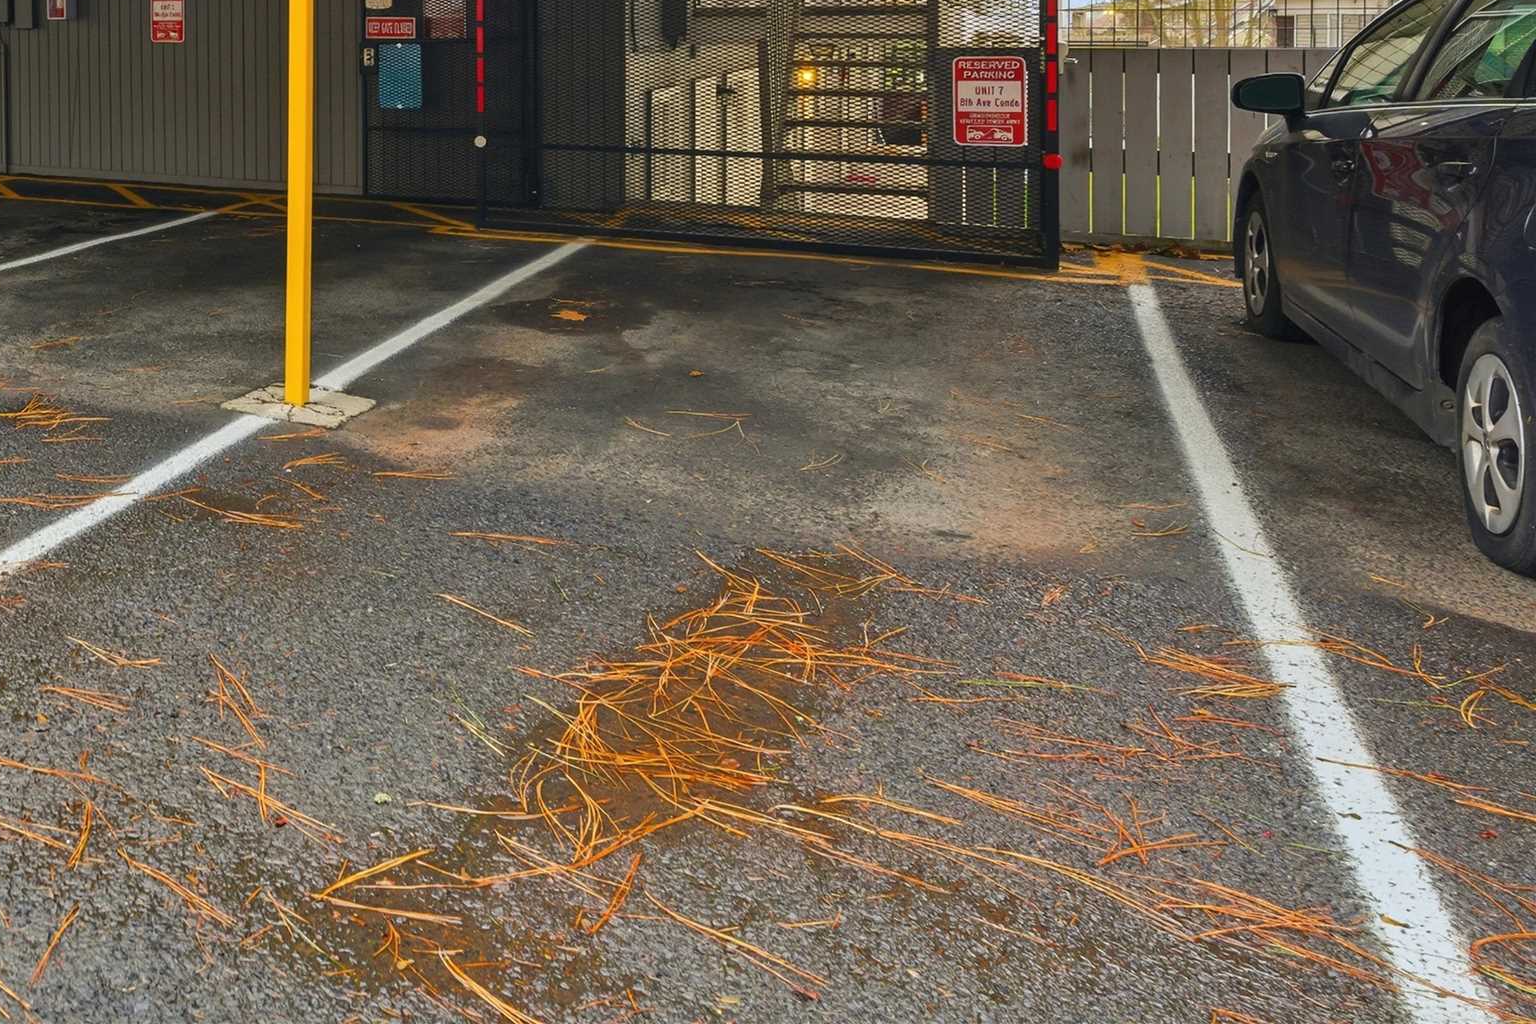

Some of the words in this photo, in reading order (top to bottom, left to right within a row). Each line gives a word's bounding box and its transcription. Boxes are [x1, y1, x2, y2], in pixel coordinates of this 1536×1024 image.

[958, 61, 1020, 69] RESERVED
[963, 70, 1015, 79] PARKING
[975, 86, 995, 95] UNIT
[998, 86, 1004, 95] 7
[976, 98, 991, 107] Ave
